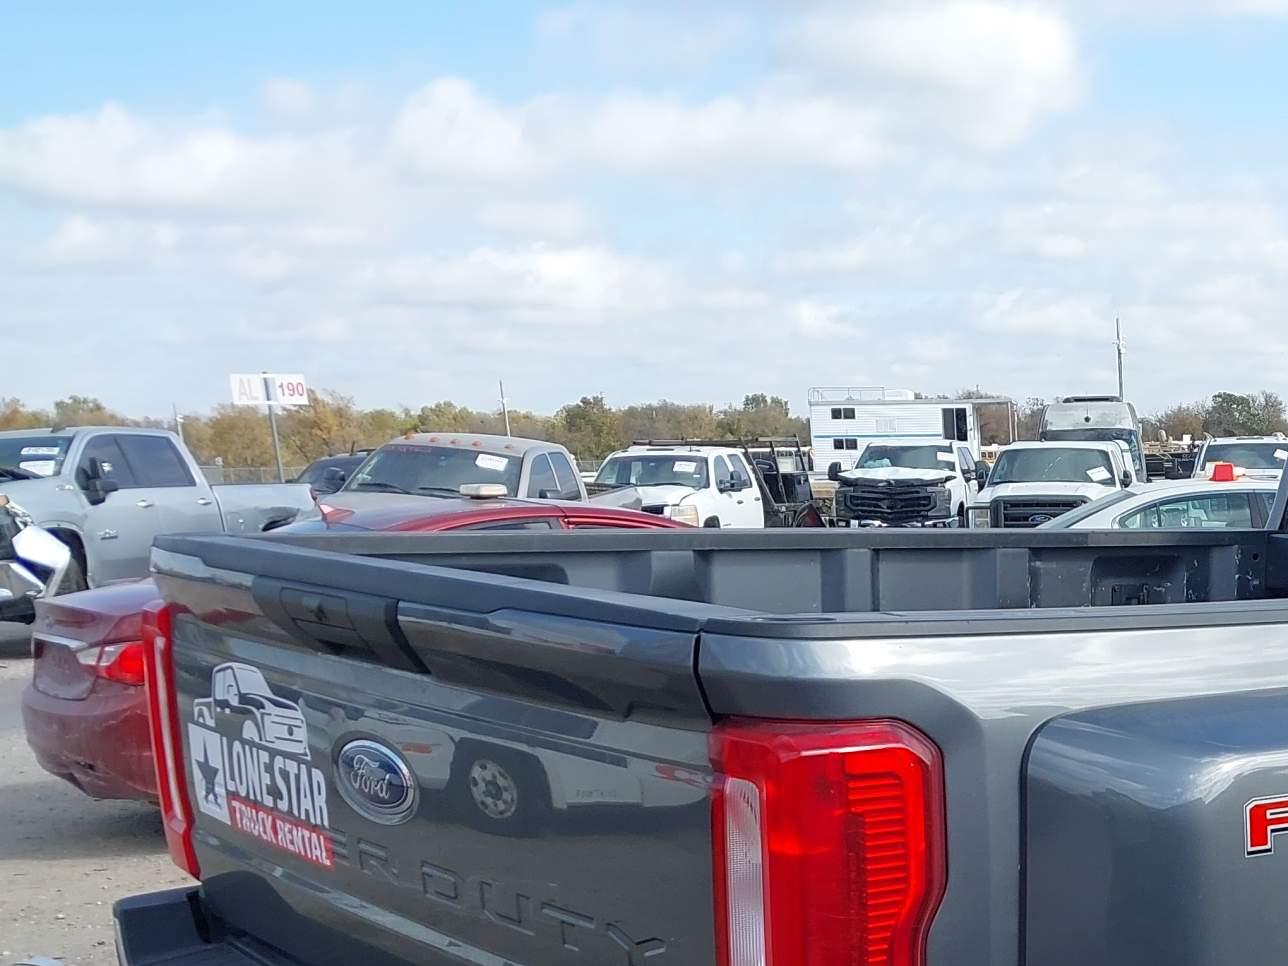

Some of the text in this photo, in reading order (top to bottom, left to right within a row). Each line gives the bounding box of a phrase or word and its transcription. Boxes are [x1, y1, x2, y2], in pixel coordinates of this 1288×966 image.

[278, 381, 305, 397] 190
[222, 736, 329, 828] LONE STAR
[351, 755, 391, 800] Ford
[231, 800, 276, 844] TRUCK
[276, 820, 331, 866] RENTAL
